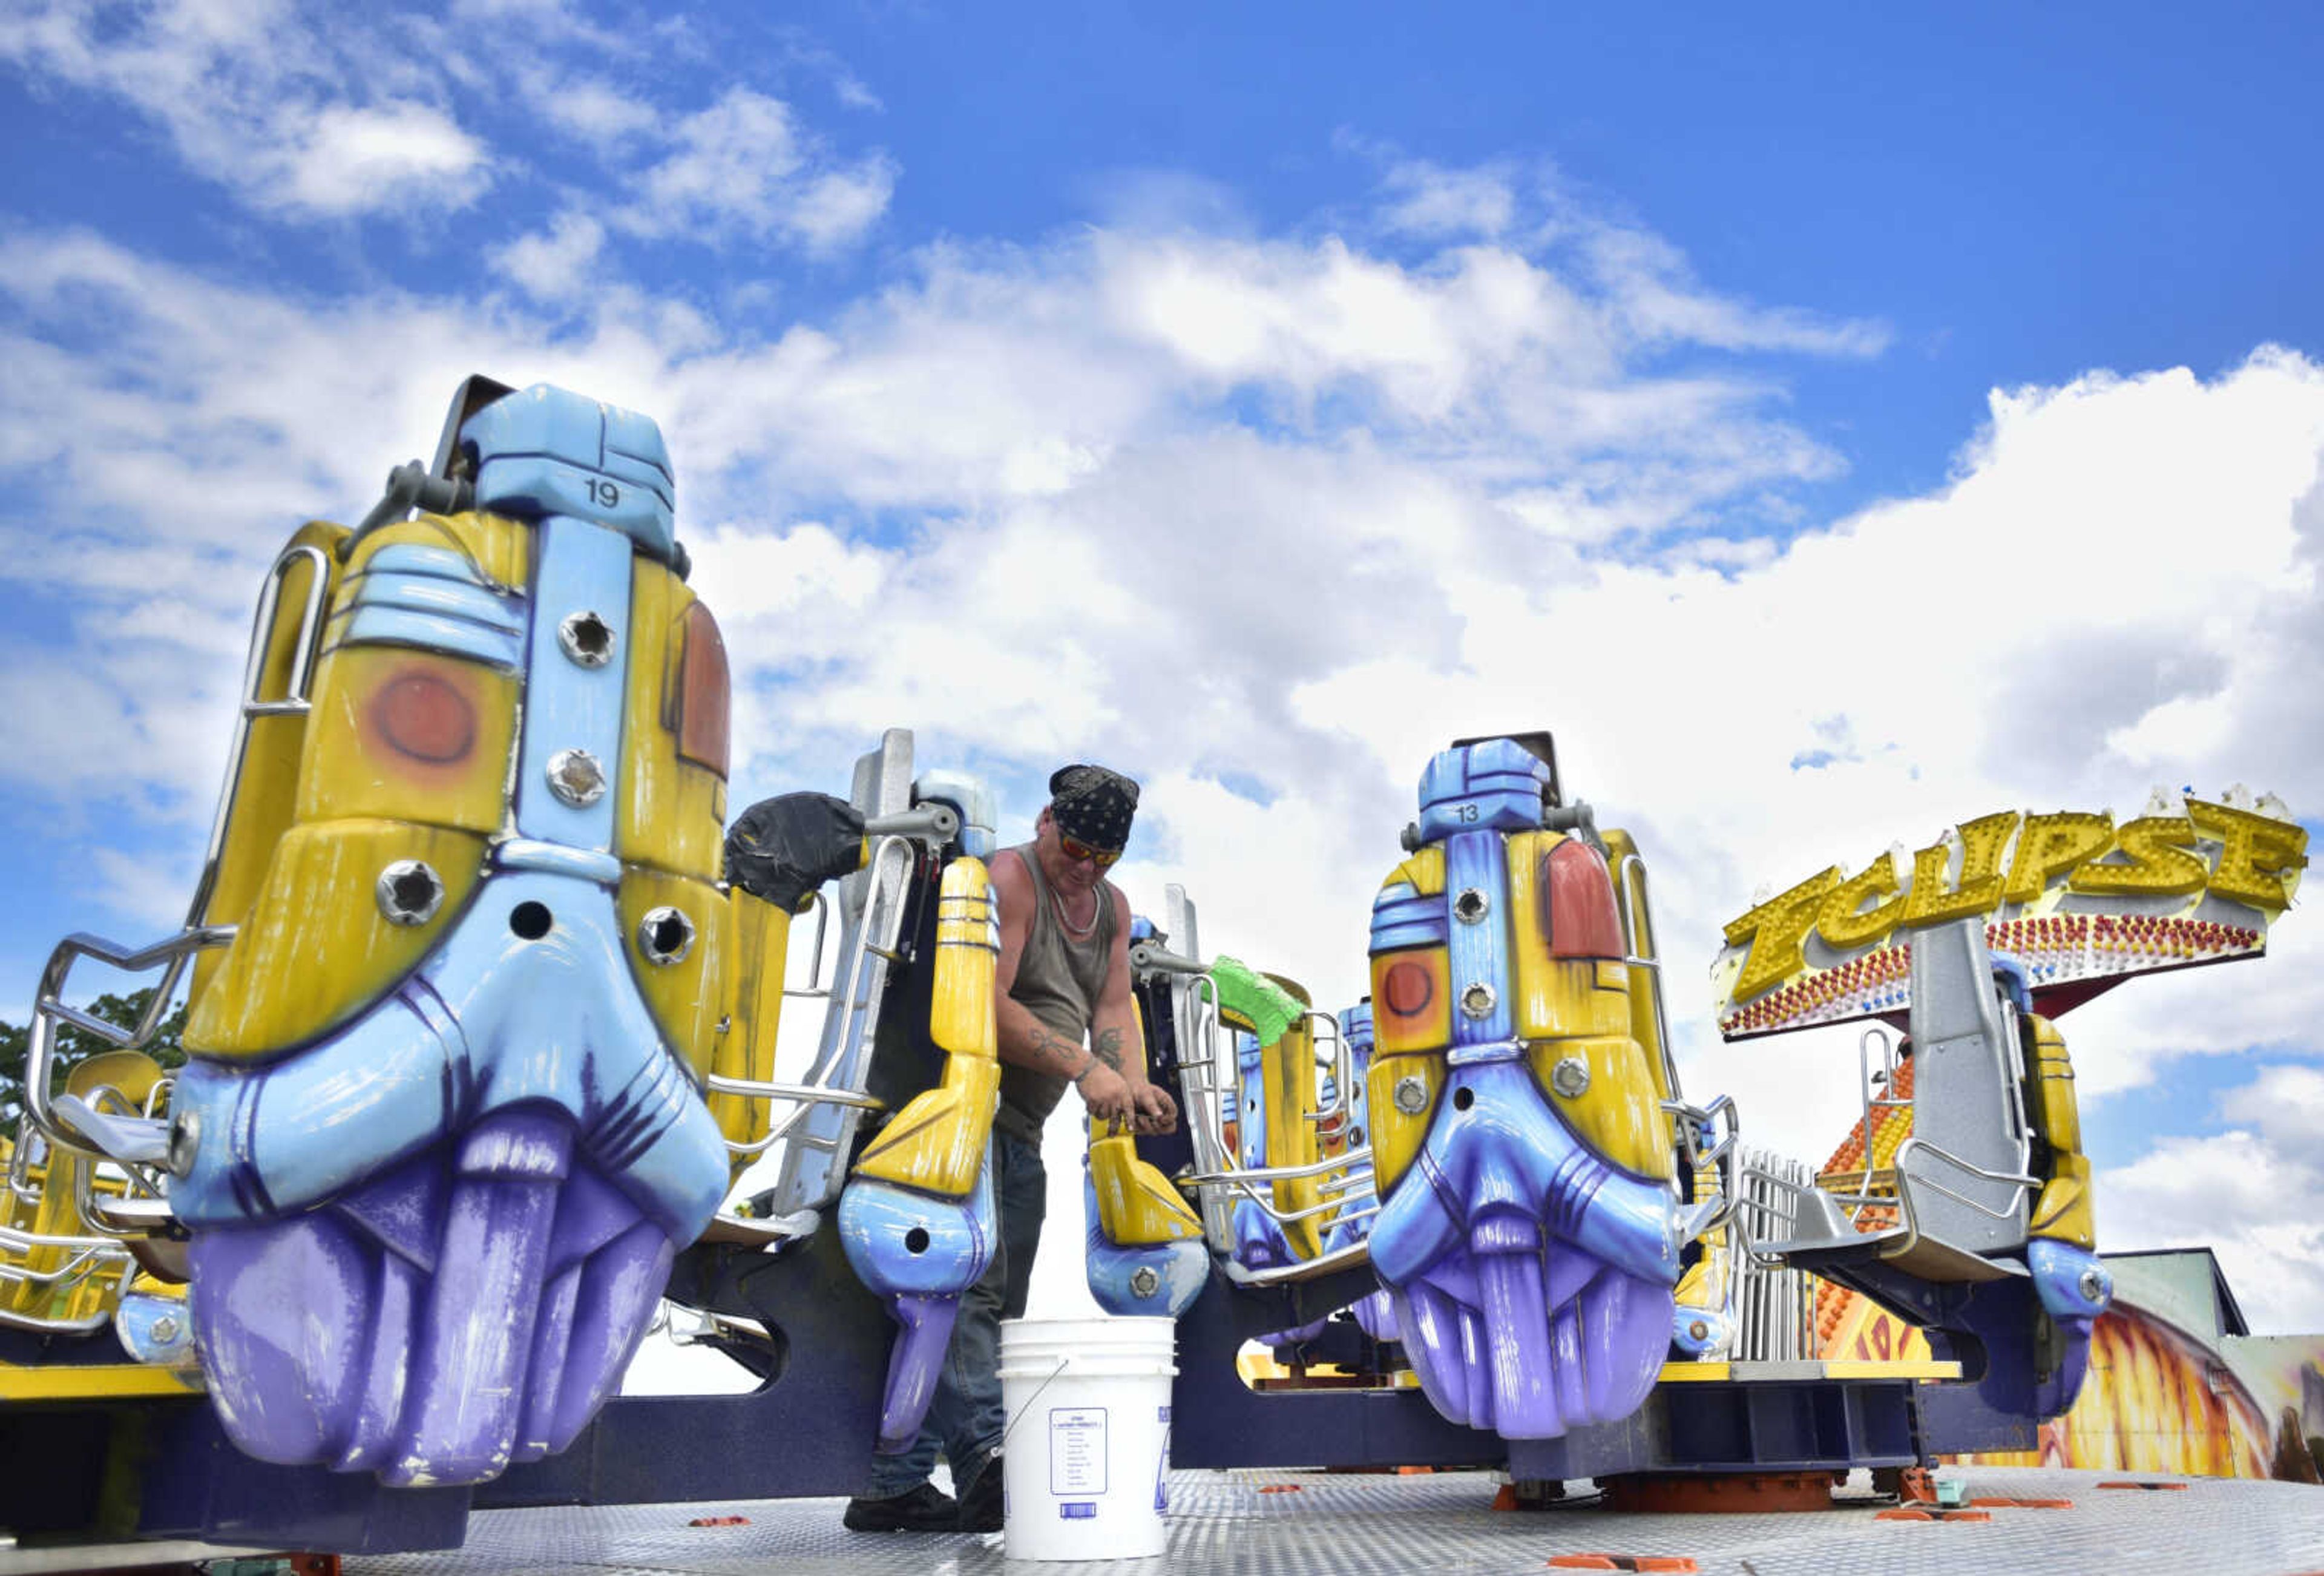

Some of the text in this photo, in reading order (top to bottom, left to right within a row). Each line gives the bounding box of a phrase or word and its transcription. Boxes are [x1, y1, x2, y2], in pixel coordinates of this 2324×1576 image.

[585, 479, 619, 508] 19
[1456, 804, 1479, 823] 13
[1723, 798, 2307, 1002] ECLIPSE
